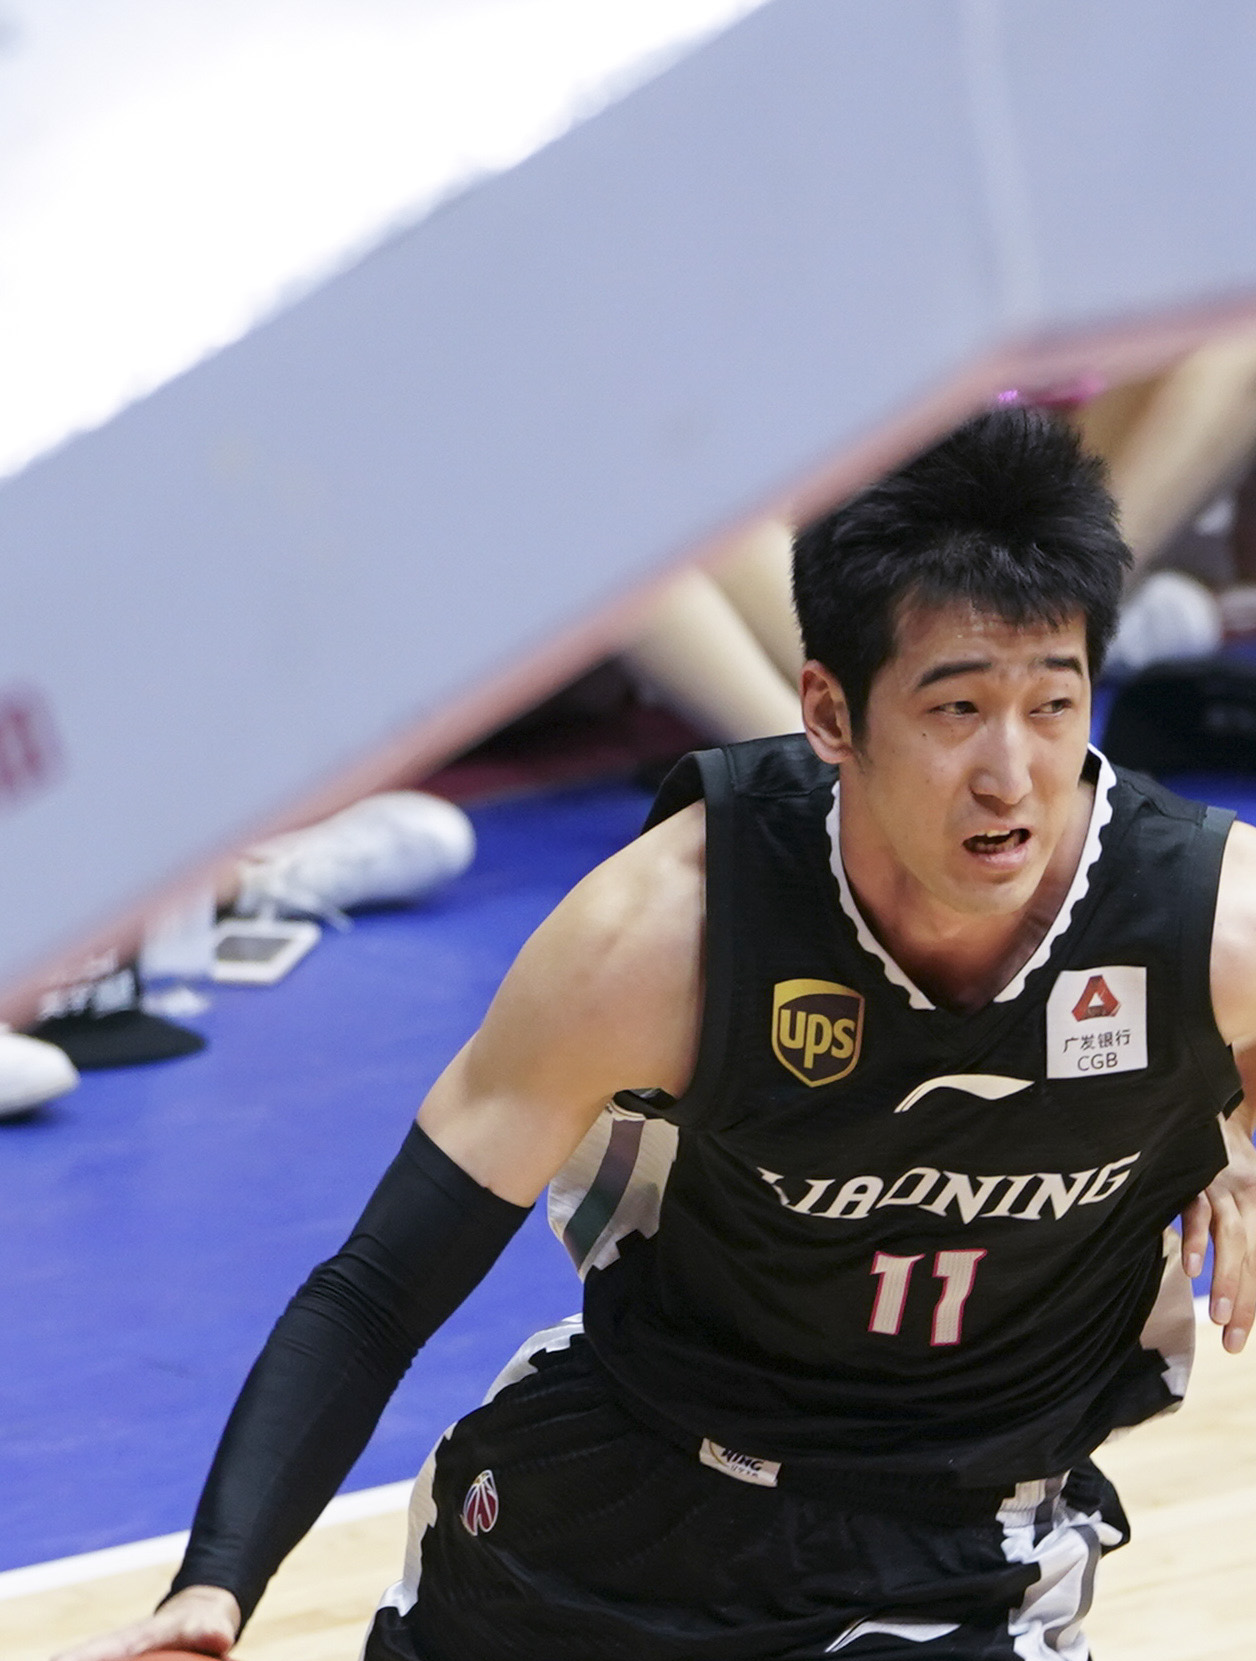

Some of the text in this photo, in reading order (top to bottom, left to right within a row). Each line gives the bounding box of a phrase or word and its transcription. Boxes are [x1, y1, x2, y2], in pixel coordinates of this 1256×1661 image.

[779, 1008, 857, 1070] ups
[1062, 1028, 1131, 1054] 广发银行
[1076, 1051, 1119, 1072] CGB
[867, 1247, 989, 1348] 11
